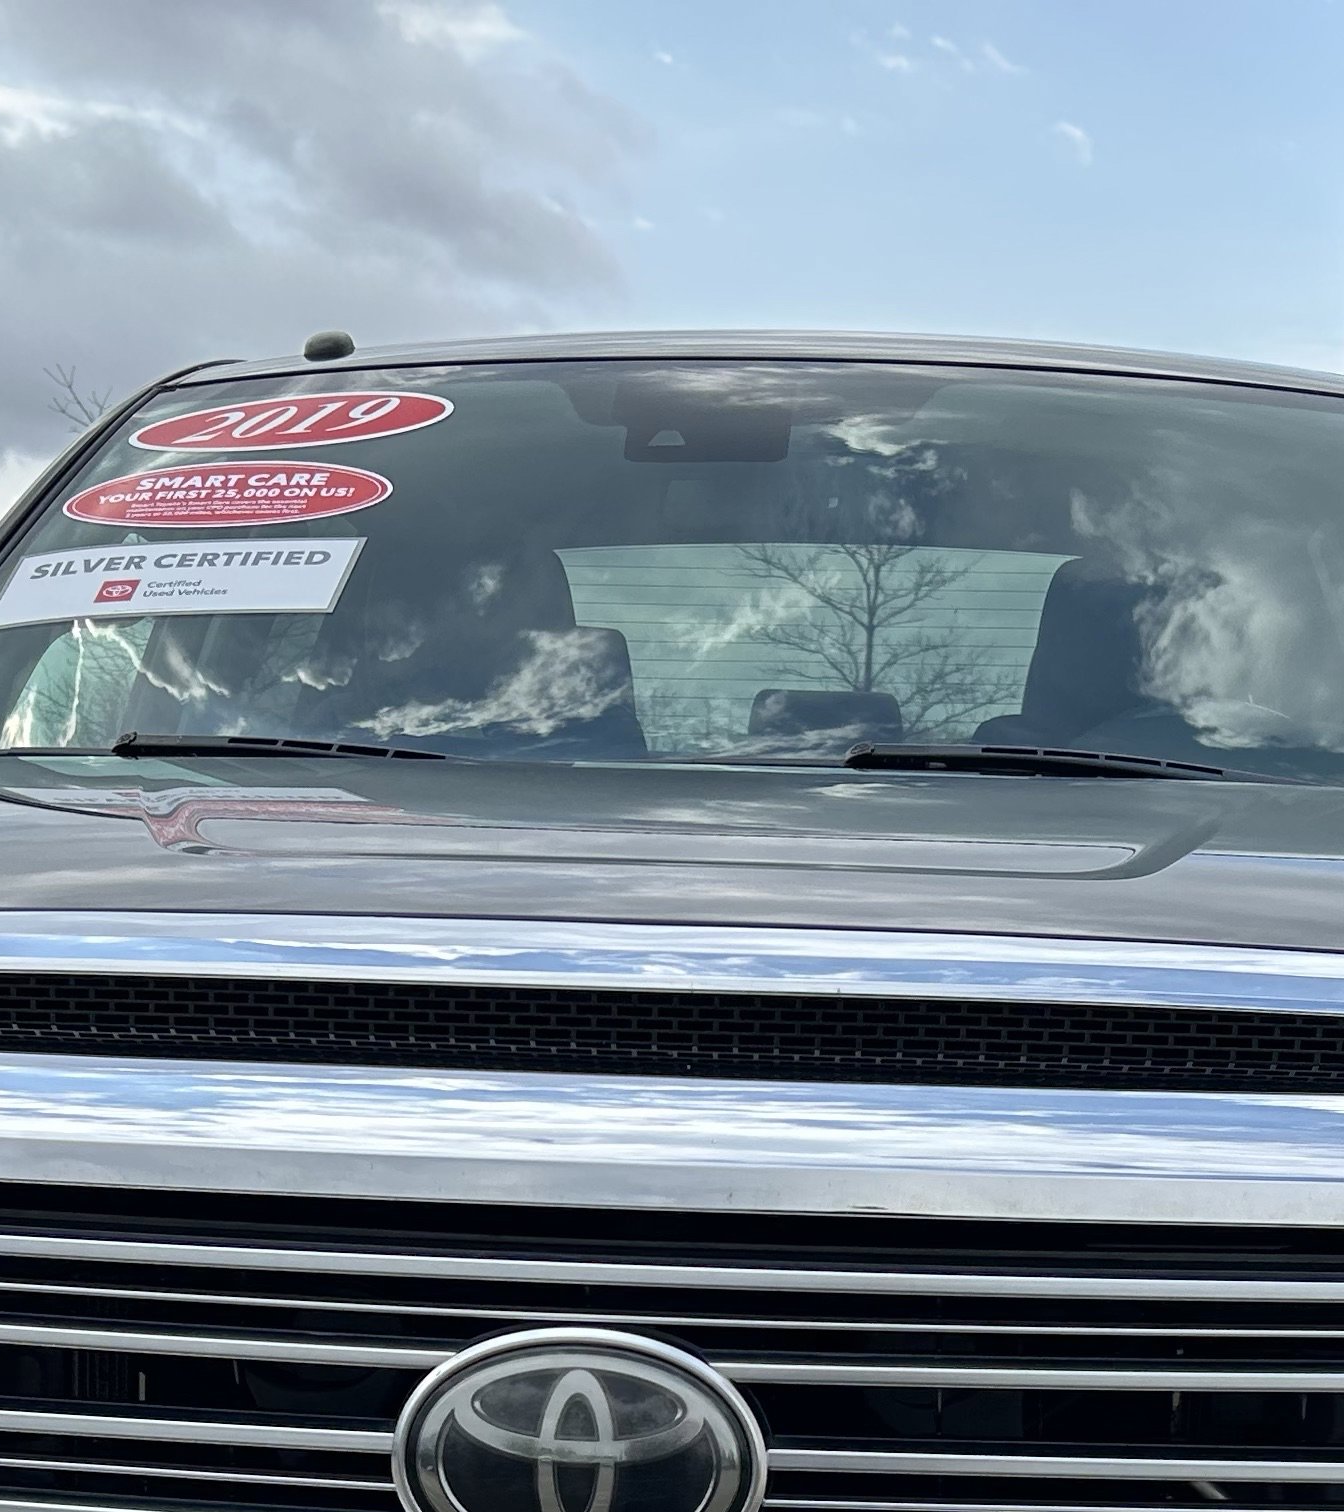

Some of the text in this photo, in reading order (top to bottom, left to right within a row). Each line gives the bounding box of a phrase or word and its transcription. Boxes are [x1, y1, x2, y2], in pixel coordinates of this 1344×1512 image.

[171, 397, 401, 444] 2019
[136, 472, 331, 490] SMART CARE
[99, 487, 356, 504] YOUR FIRST 25,000 ON US!
[30, 550, 332, 580] SILVER CERTIFIED
[147, 579, 203, 588] Certified
[142, 588, 228, 597] Used Vehicles
